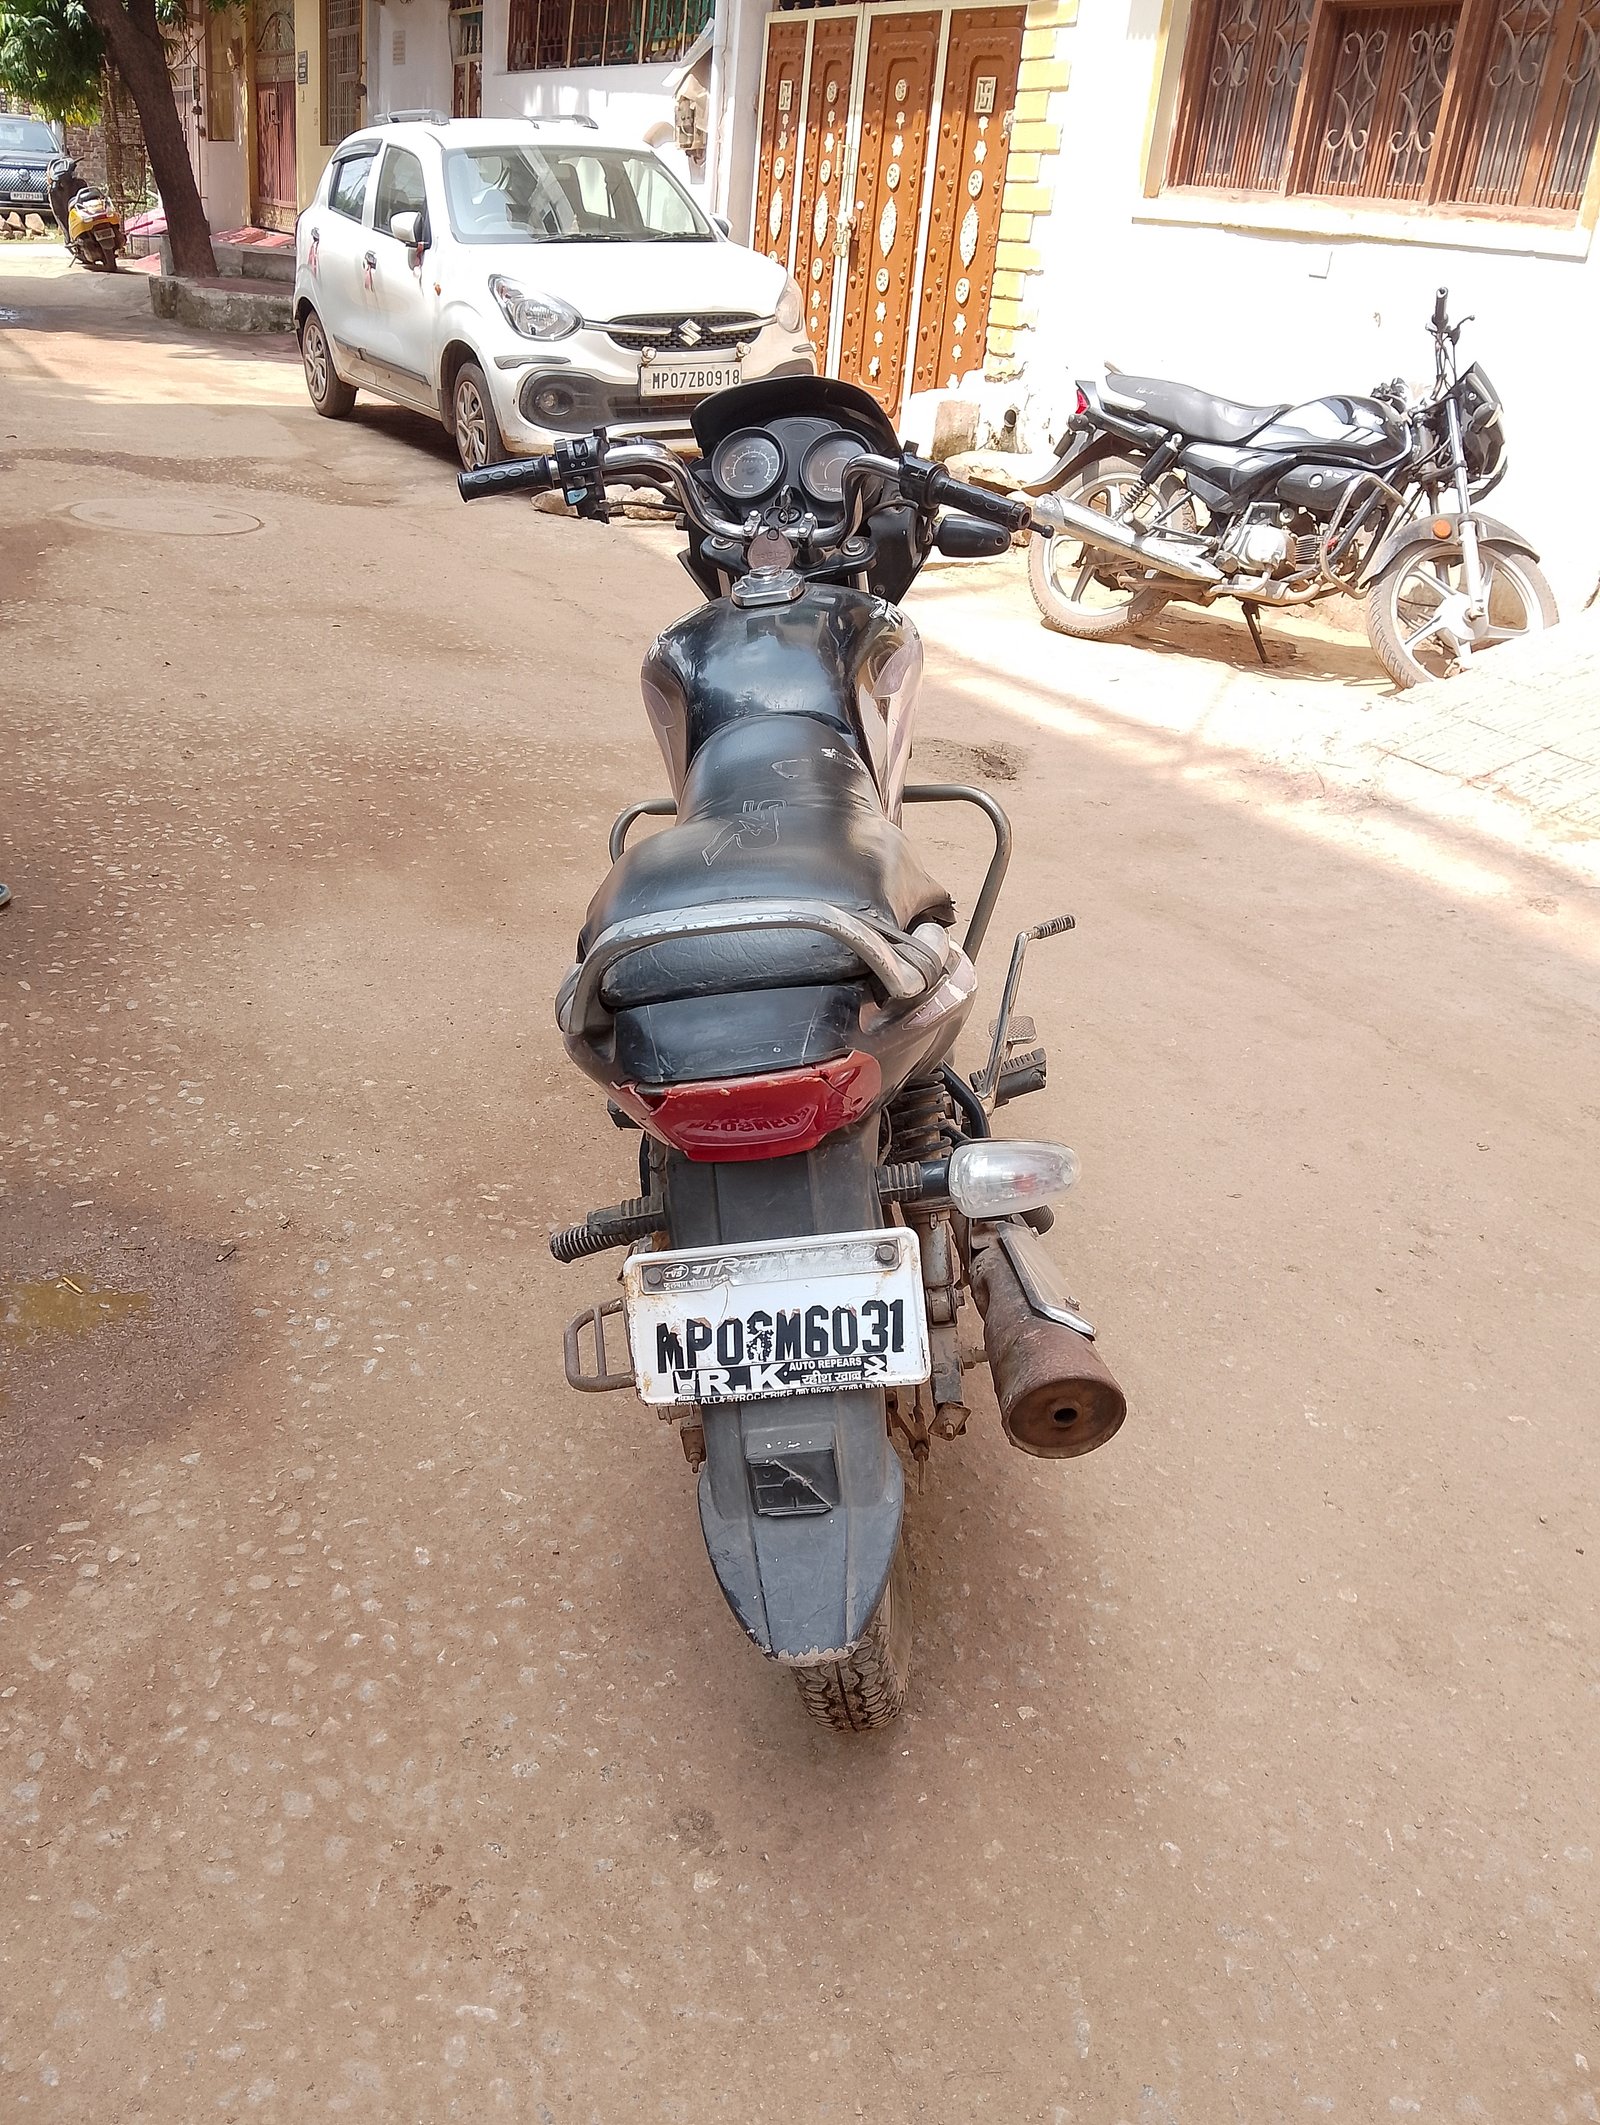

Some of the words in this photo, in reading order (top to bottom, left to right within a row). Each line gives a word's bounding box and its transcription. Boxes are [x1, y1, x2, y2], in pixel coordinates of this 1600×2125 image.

[652, 369, 740, 389] MP07ZB0918
[789, 1361, 815, 1371] AUTO
[818, 1357, 862, 1369] REPEARS
